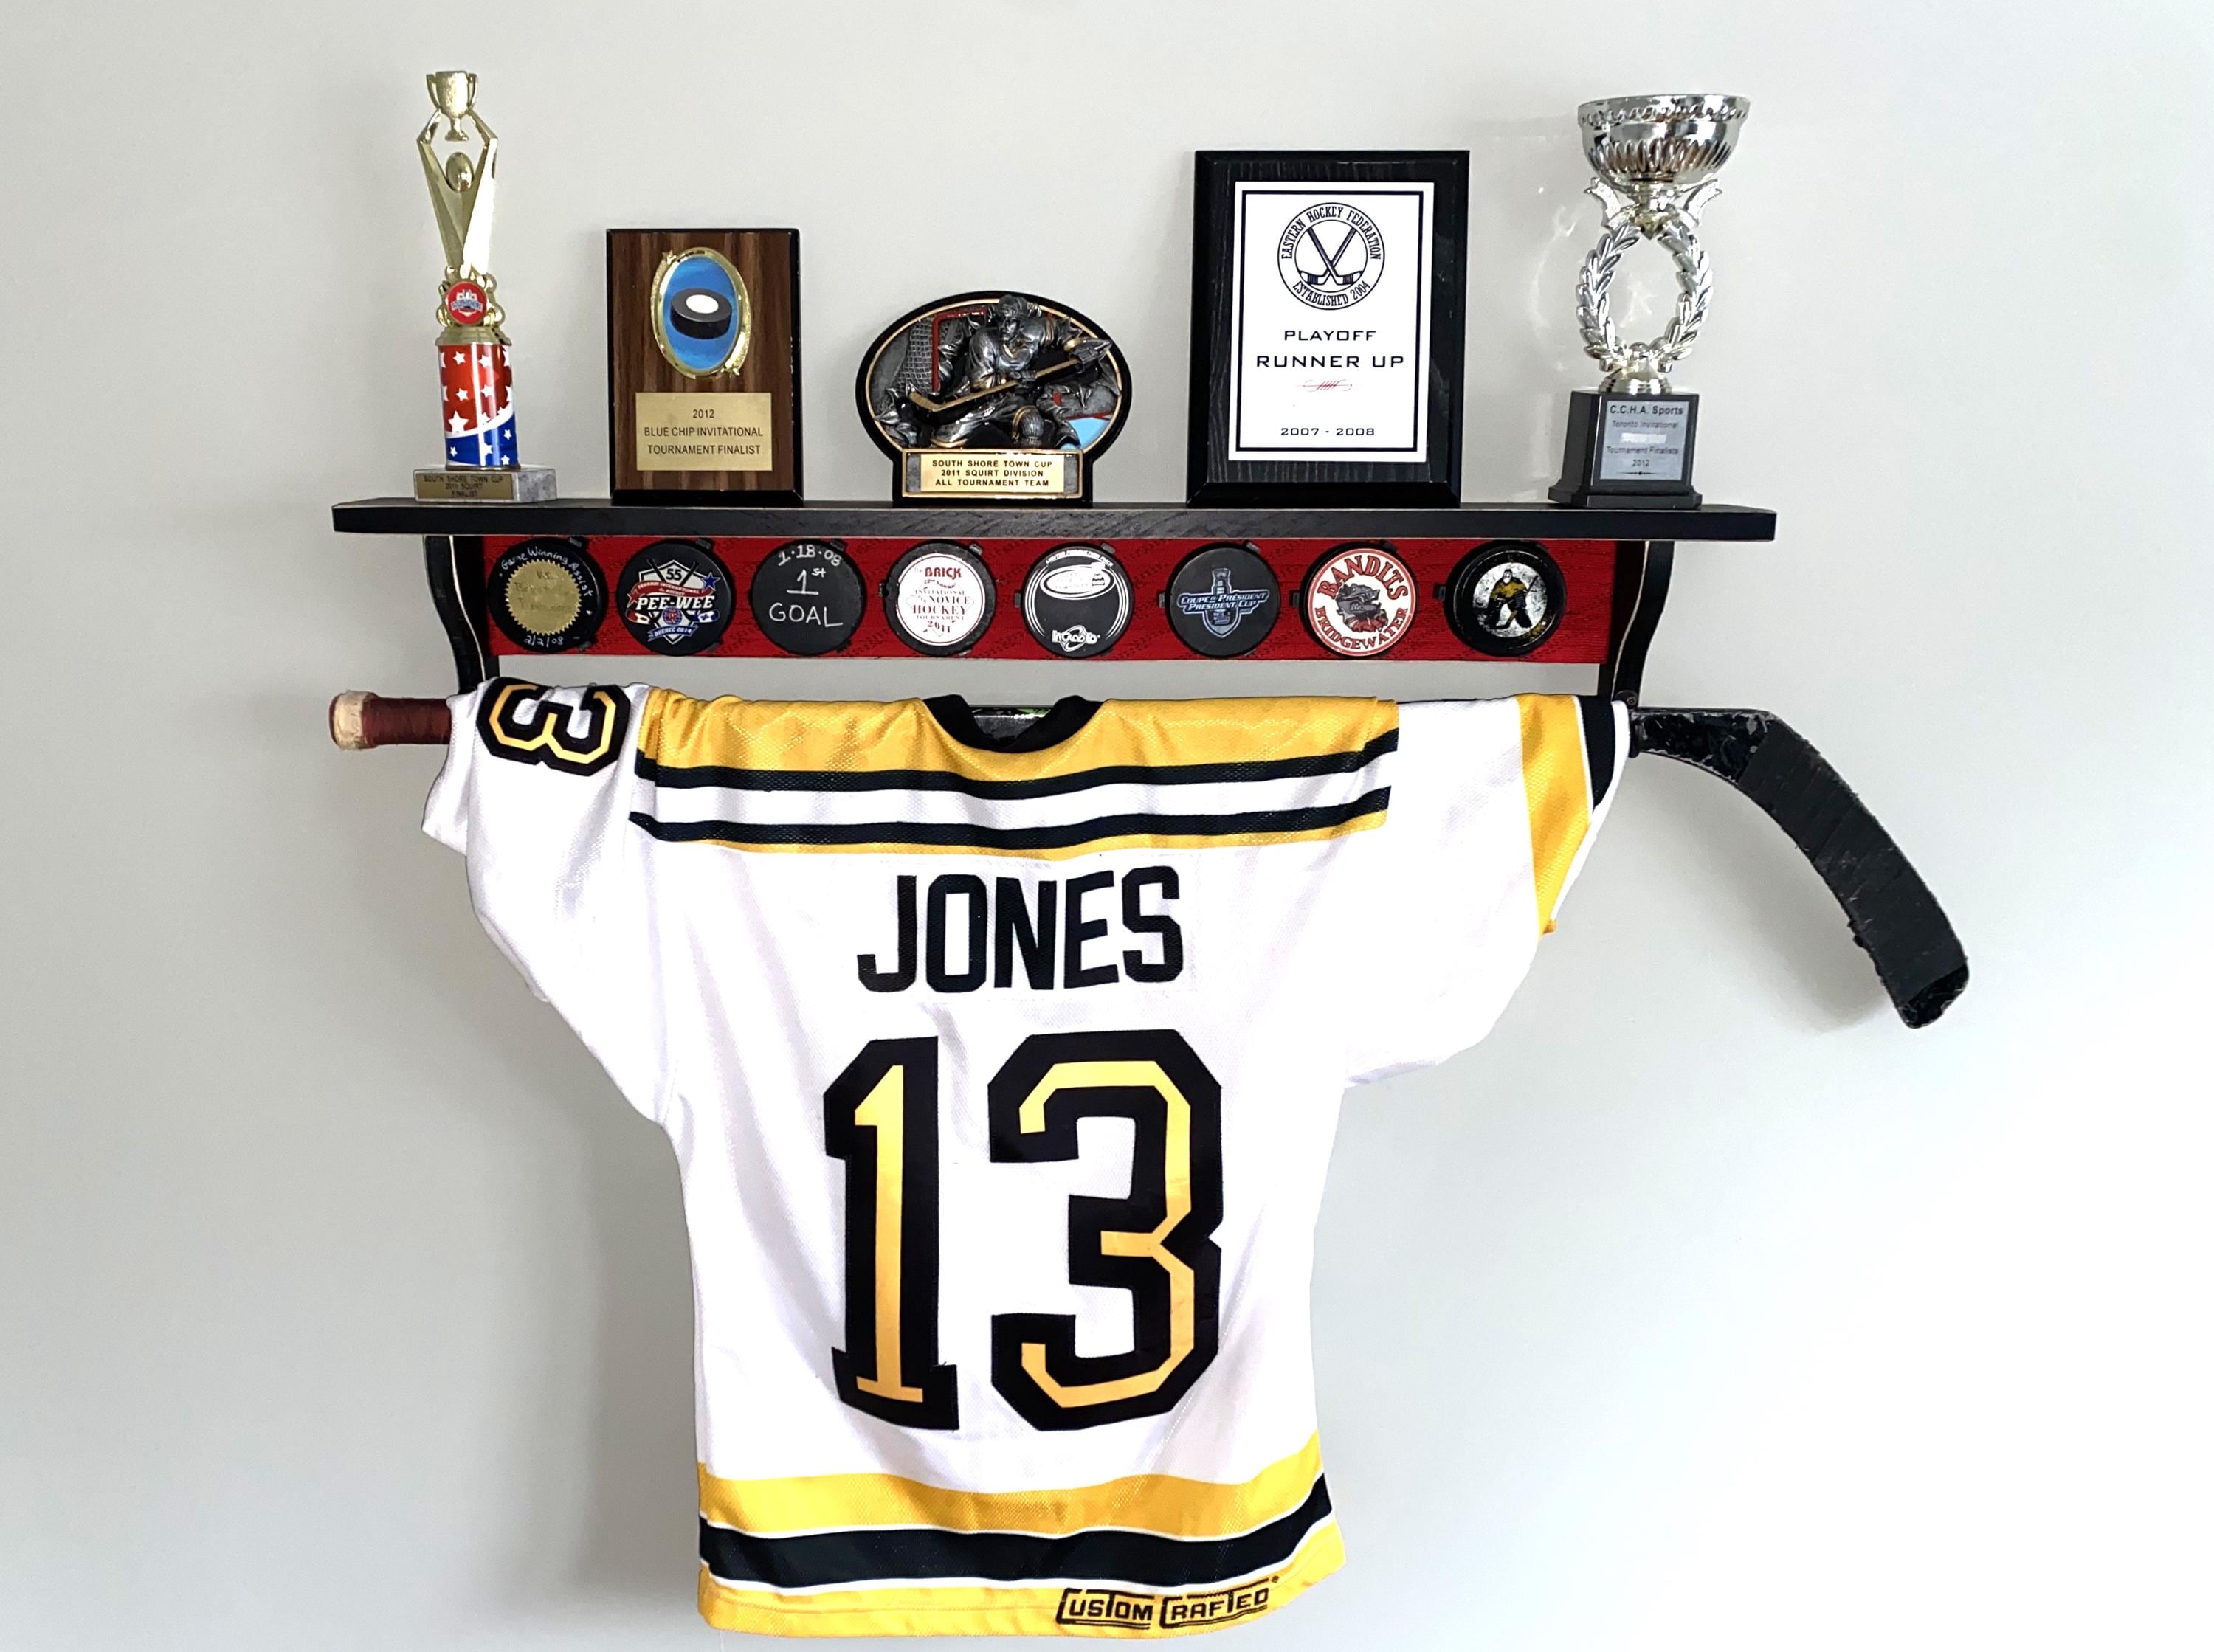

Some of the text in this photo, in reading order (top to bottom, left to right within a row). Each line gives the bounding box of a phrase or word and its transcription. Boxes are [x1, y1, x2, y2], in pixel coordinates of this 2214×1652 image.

[1281, 206, 1382, 260] EASTERN HOCKEY FEDERATION
[1292, 280, 1370, 306] ESTABLISHED 2004
[1284, 331, 1376, 341] PLAYOFF
[1257, 356, 1404, 367] RUNNER UP
[692, 409, 714, 418] 2012
[1652, 405, 1683, 416] Sports
[644, 427, 763, 437] BLUE CHIP INVITATIONAL
[648, 445, 761, 455] TOURNAMENT FINALIST
[1607, 446, 1648, 454] Tournament
[1632, 459, 1650, 467] 2012
[501, 553, 528, 570] Game
[527, 546, 568, 565] Winning
[568, 562, 593, 596] Assist
[666, 568, 682, 581] 55
[925, 567, 962, 579] BRICK
[1317, 555, 1409, 601] BANDITS
[635, 595, 715, 610] PEE-WEE
[769, 602, 844, 627] GOAL
[913, 605, 965, 615] HOCKEY
[927, 621, 951, 633] 2011
[1315, 606, 1409, 649] BRIDGEWATER
[523, 635, 564, 647] 2/2/08
[857, 865, 1184, 994] JONES
[823, 1029, 1224, 1432] 13
[1055, 1588, 1155, 1630] CUSTOM
